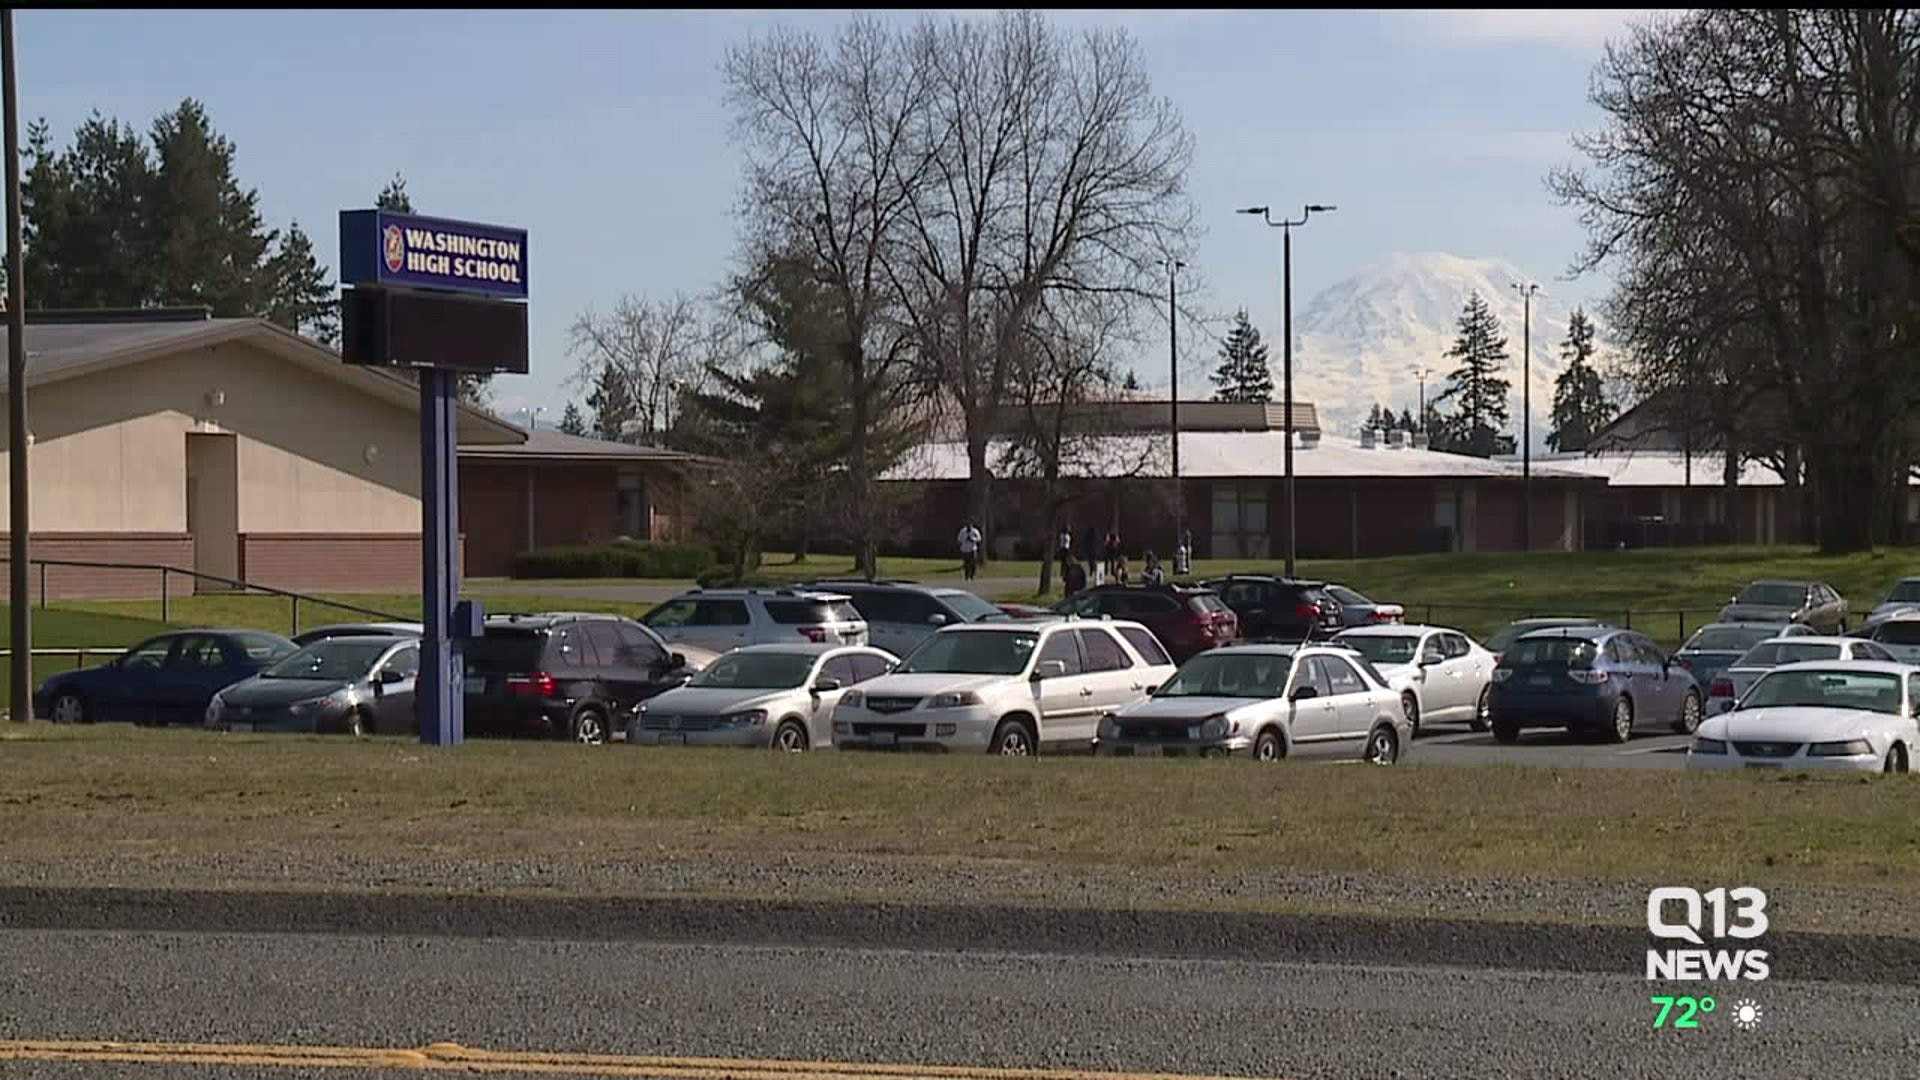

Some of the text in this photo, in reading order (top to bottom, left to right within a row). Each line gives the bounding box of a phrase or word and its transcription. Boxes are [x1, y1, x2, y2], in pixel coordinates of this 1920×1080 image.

[405, 228, 519, 262] WASHINGTON
[407, 252, 520, 283] HIGH SCHOOL
